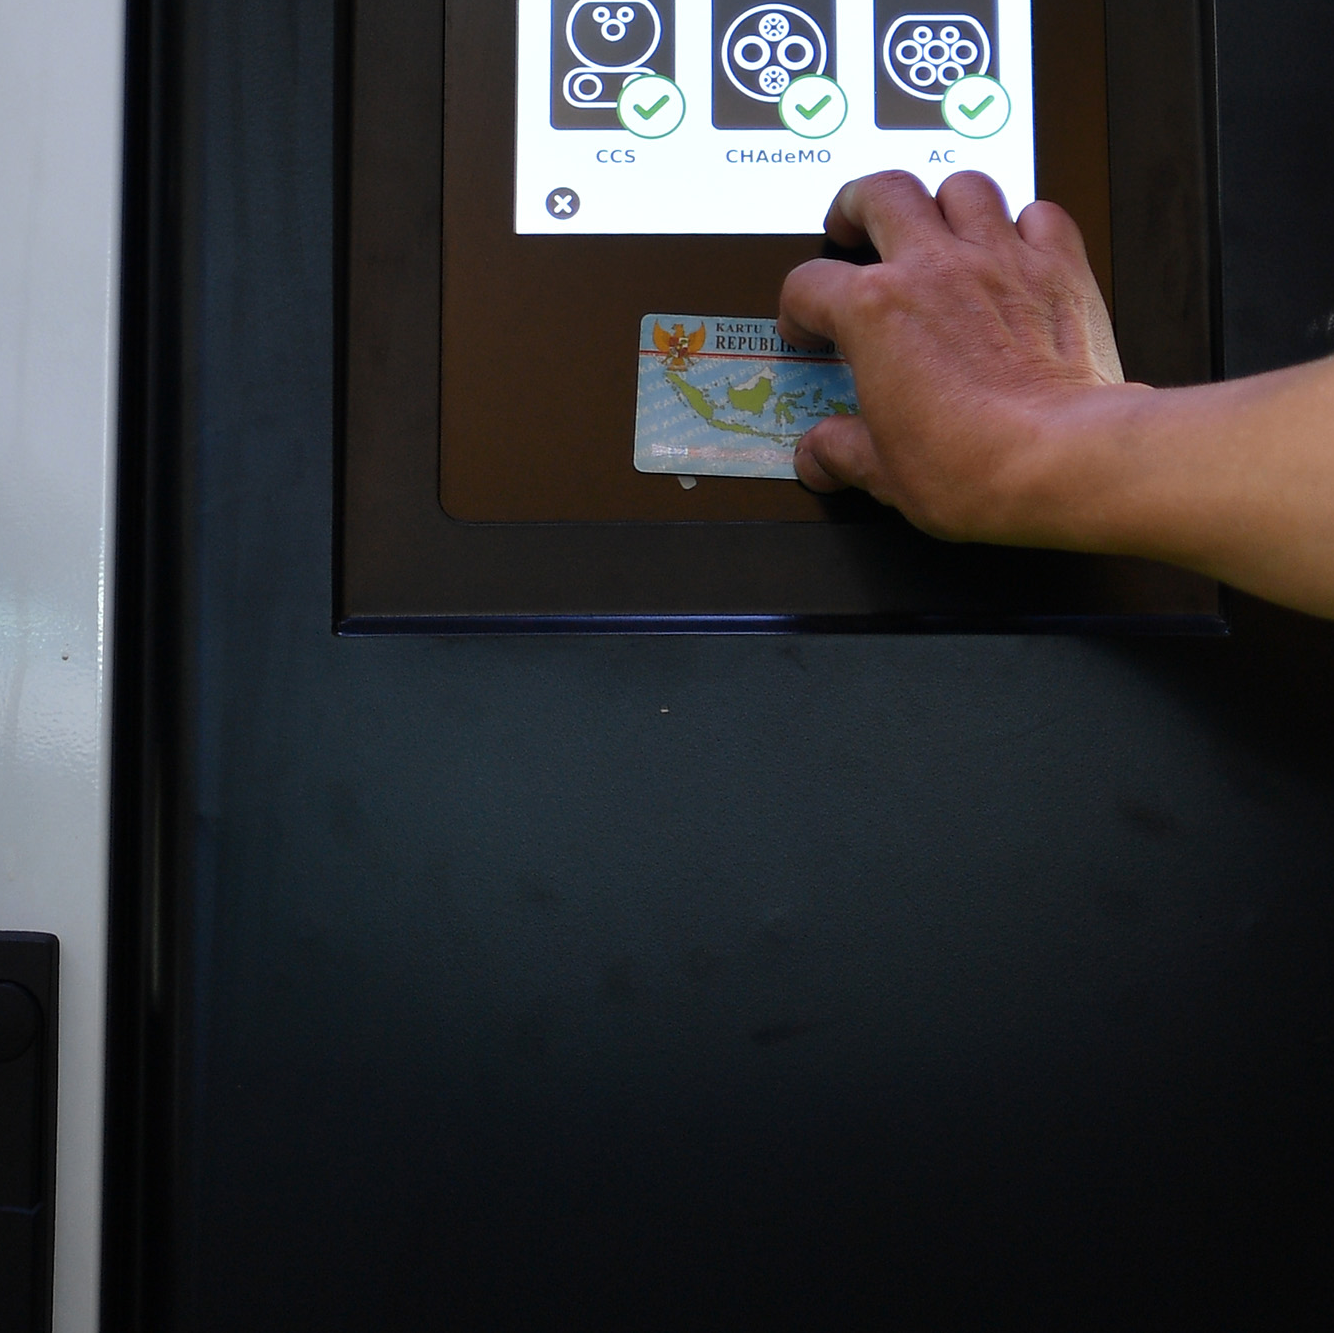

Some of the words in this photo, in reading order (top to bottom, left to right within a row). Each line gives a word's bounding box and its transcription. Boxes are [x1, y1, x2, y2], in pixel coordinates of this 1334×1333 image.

[595, 149, 637, 164] CCS
[725, 149, 832, 164] CHAdeMO
[927, 149, 957, 164] AC
[715, 322, 763, 335] KARTU
